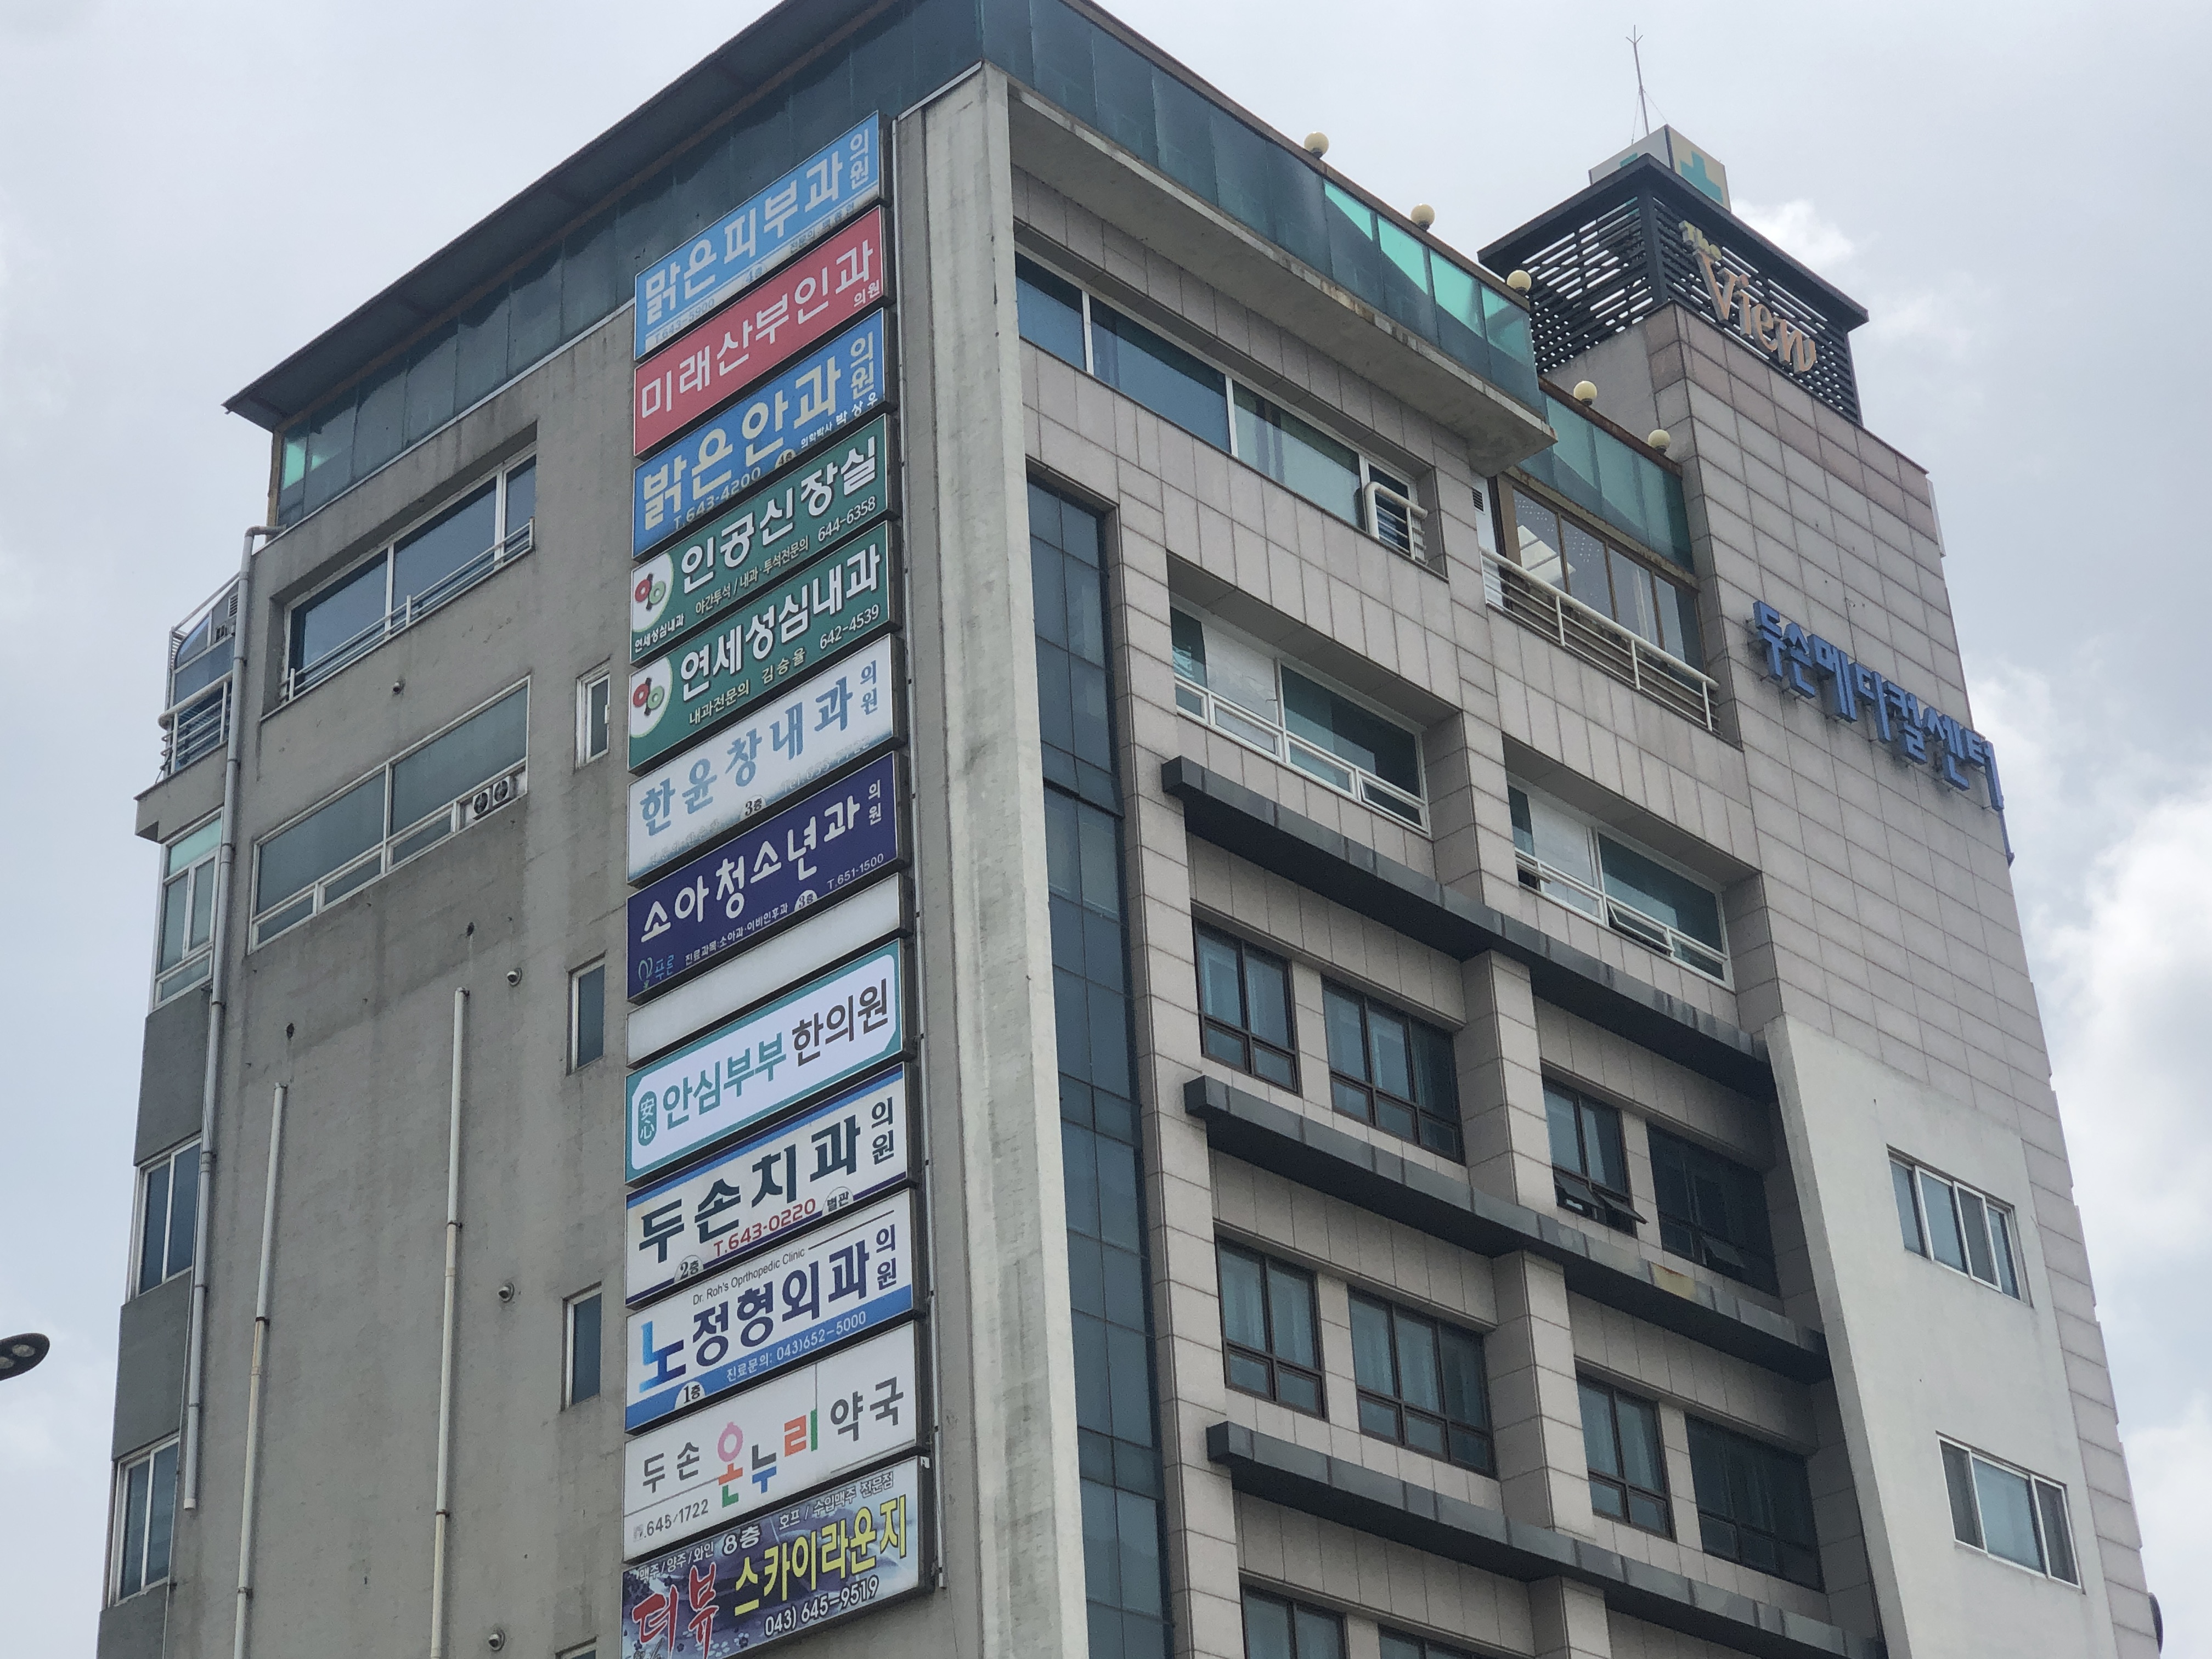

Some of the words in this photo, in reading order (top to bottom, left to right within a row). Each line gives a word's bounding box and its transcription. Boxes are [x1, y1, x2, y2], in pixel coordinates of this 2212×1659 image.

[646, 152, 843, 325] 맑은피부과
[850, 128, 869, 190] 의원
[642, 239, 873, 418] 미래산부인과
[854, 280, 880, 308] 의원
[1692, 249, 1816, 374] View
[644, 357, 840, 531] 밝은안과
[850, 331, 873, 400] 의원
[681, 437, 876, 594] 인공신장실
[817, 495, 876, 542] 644-6358
[634, 612, 684, 653] 연세성심내과
[680, 544, 880, 701] 연세성심내과
[689, 682, 750, 726] 내과전문의
[820, 603, 879, 650] 642-4539
[639, 676, 854, 837] 한윤창내과
[860, 661, 878, 715] 의원
[1753, 600, 2004, 812] 두손메디컬센터
[641, 795, 860, 943] 소아청소년과
[868, 779, 882, 826] 의원
[826, 853, 884, 891] T.651-1500
[654, 954, 675, 981] 푸른
[639, 1115, 861, 1264] 두손치과
[871, 1097, 895, 1165] 의원
[639, 1240, 870, 1393] 노정형외과
[876, 1224, 897, 1291] 의원
[680, 1260, 699, 1278] 2층
[693, 1293, 704, 1306] Dr.
[707, 1280, 729, 1300] Roh's
[782, 1247, 805, 1267] Clinic
[683, 1384, 701, 1404] 1층
[776, 1311, 867, 1362] 043)652-5000
[721, 1523, 763, 1557] 8층
[734, 1493, 907, 1617] 스카이라운지
